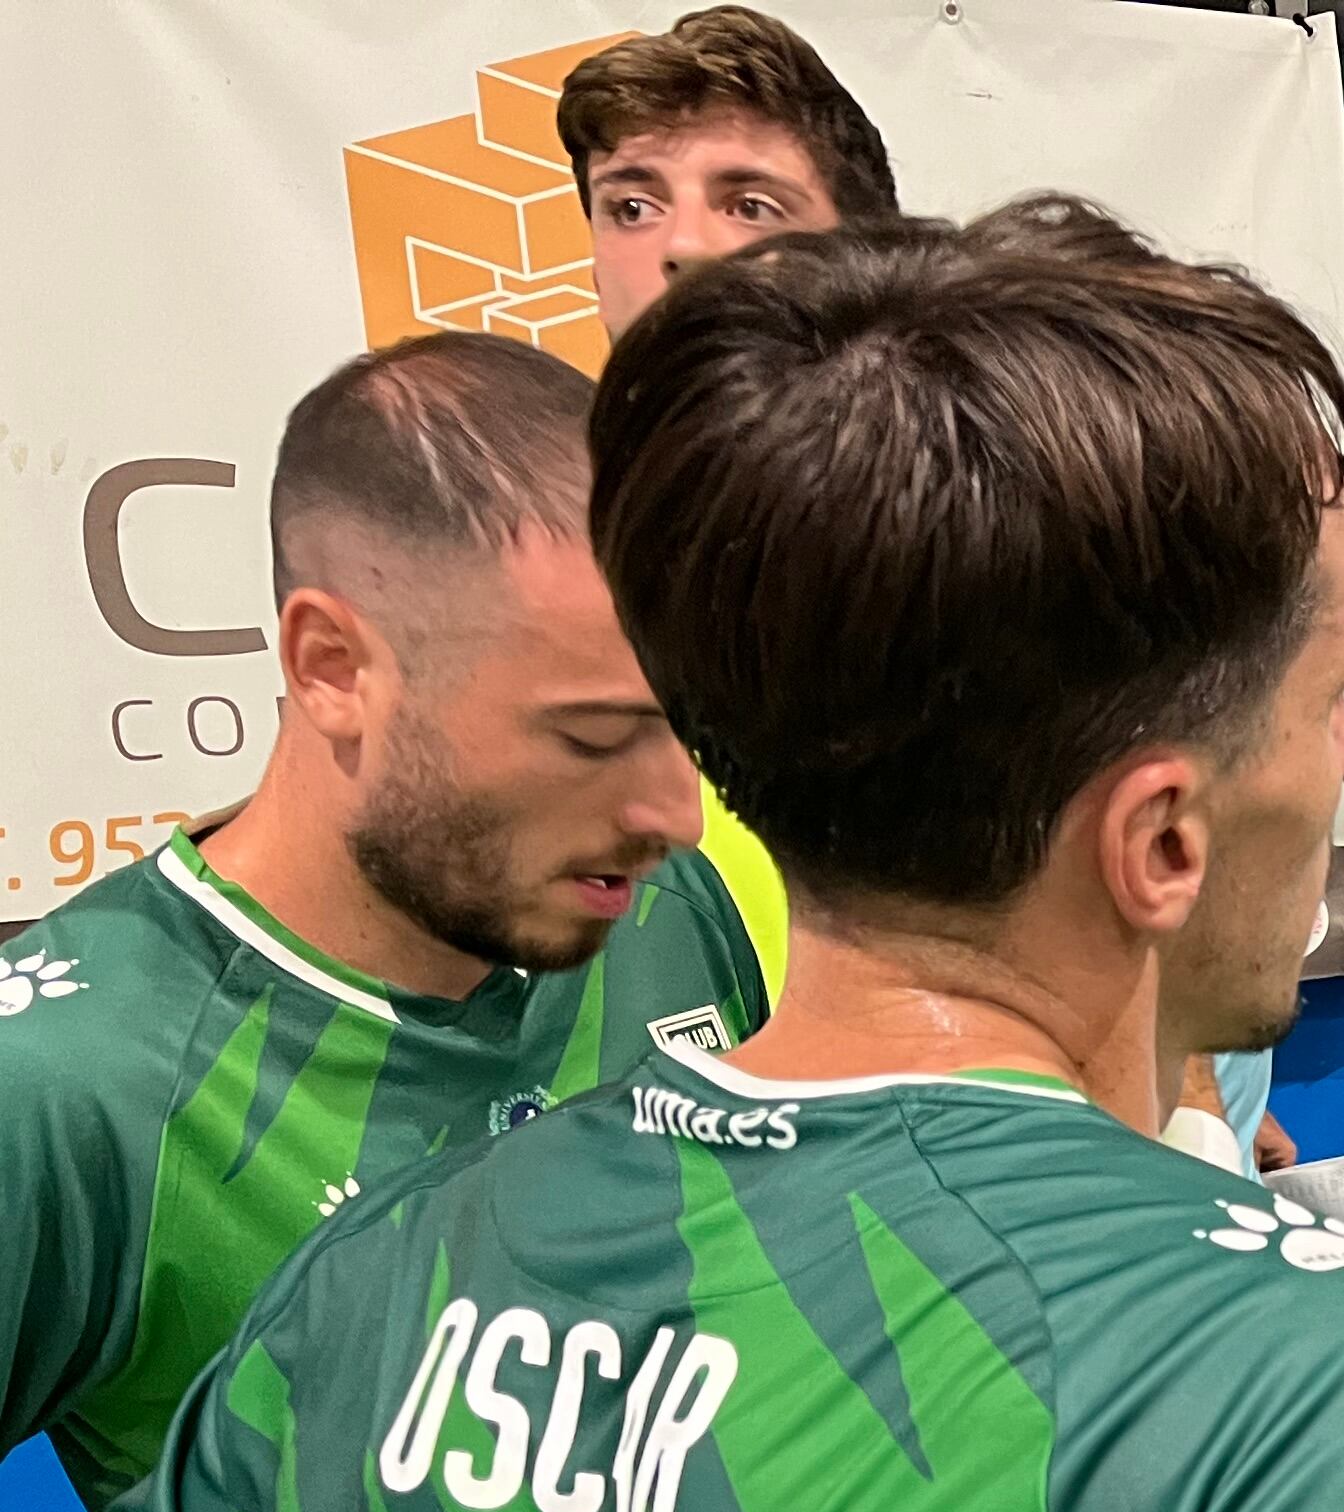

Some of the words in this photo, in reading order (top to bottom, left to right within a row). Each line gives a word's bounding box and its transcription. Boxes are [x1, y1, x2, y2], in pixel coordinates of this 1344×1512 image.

[112, 695, 288, 761] CO
[50, 811, 193, 886] 95
[632, 1086, 801, 1151] uma.es
